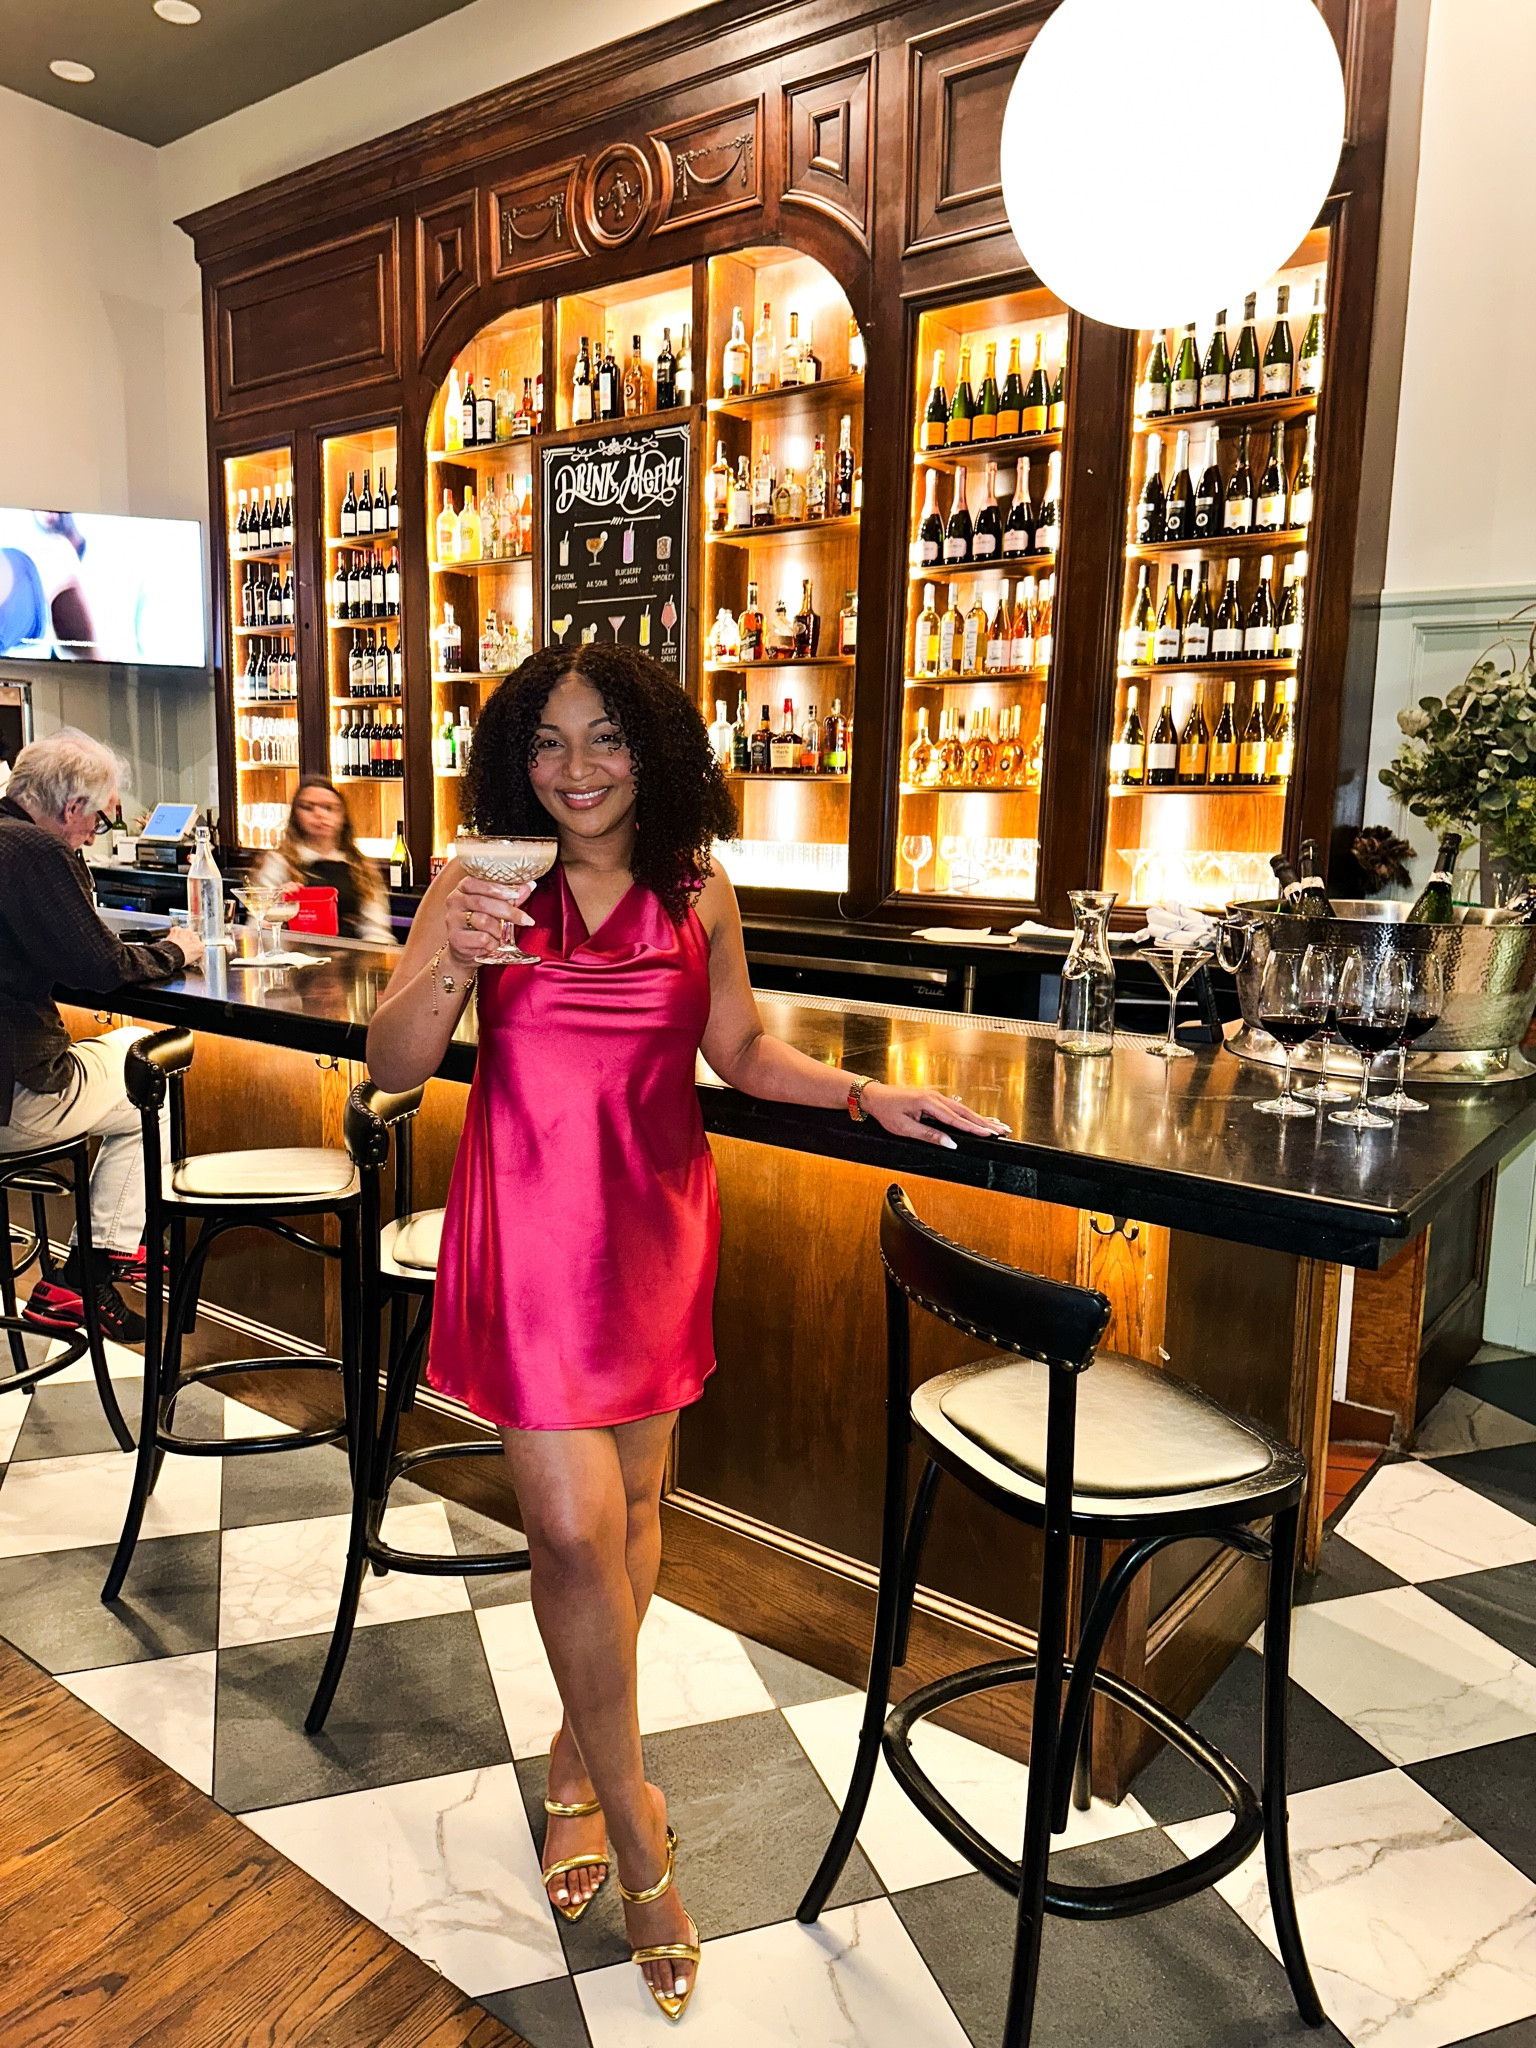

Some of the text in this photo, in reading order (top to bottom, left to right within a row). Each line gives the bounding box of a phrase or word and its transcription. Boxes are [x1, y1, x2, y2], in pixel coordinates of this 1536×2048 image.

[554, 573, 575, 582] FROZEN
[619, 577, 638, 586] SMASH
[652, 573, 675, 582] SMOKEY
[661, 646, 677, 655] BERRY
